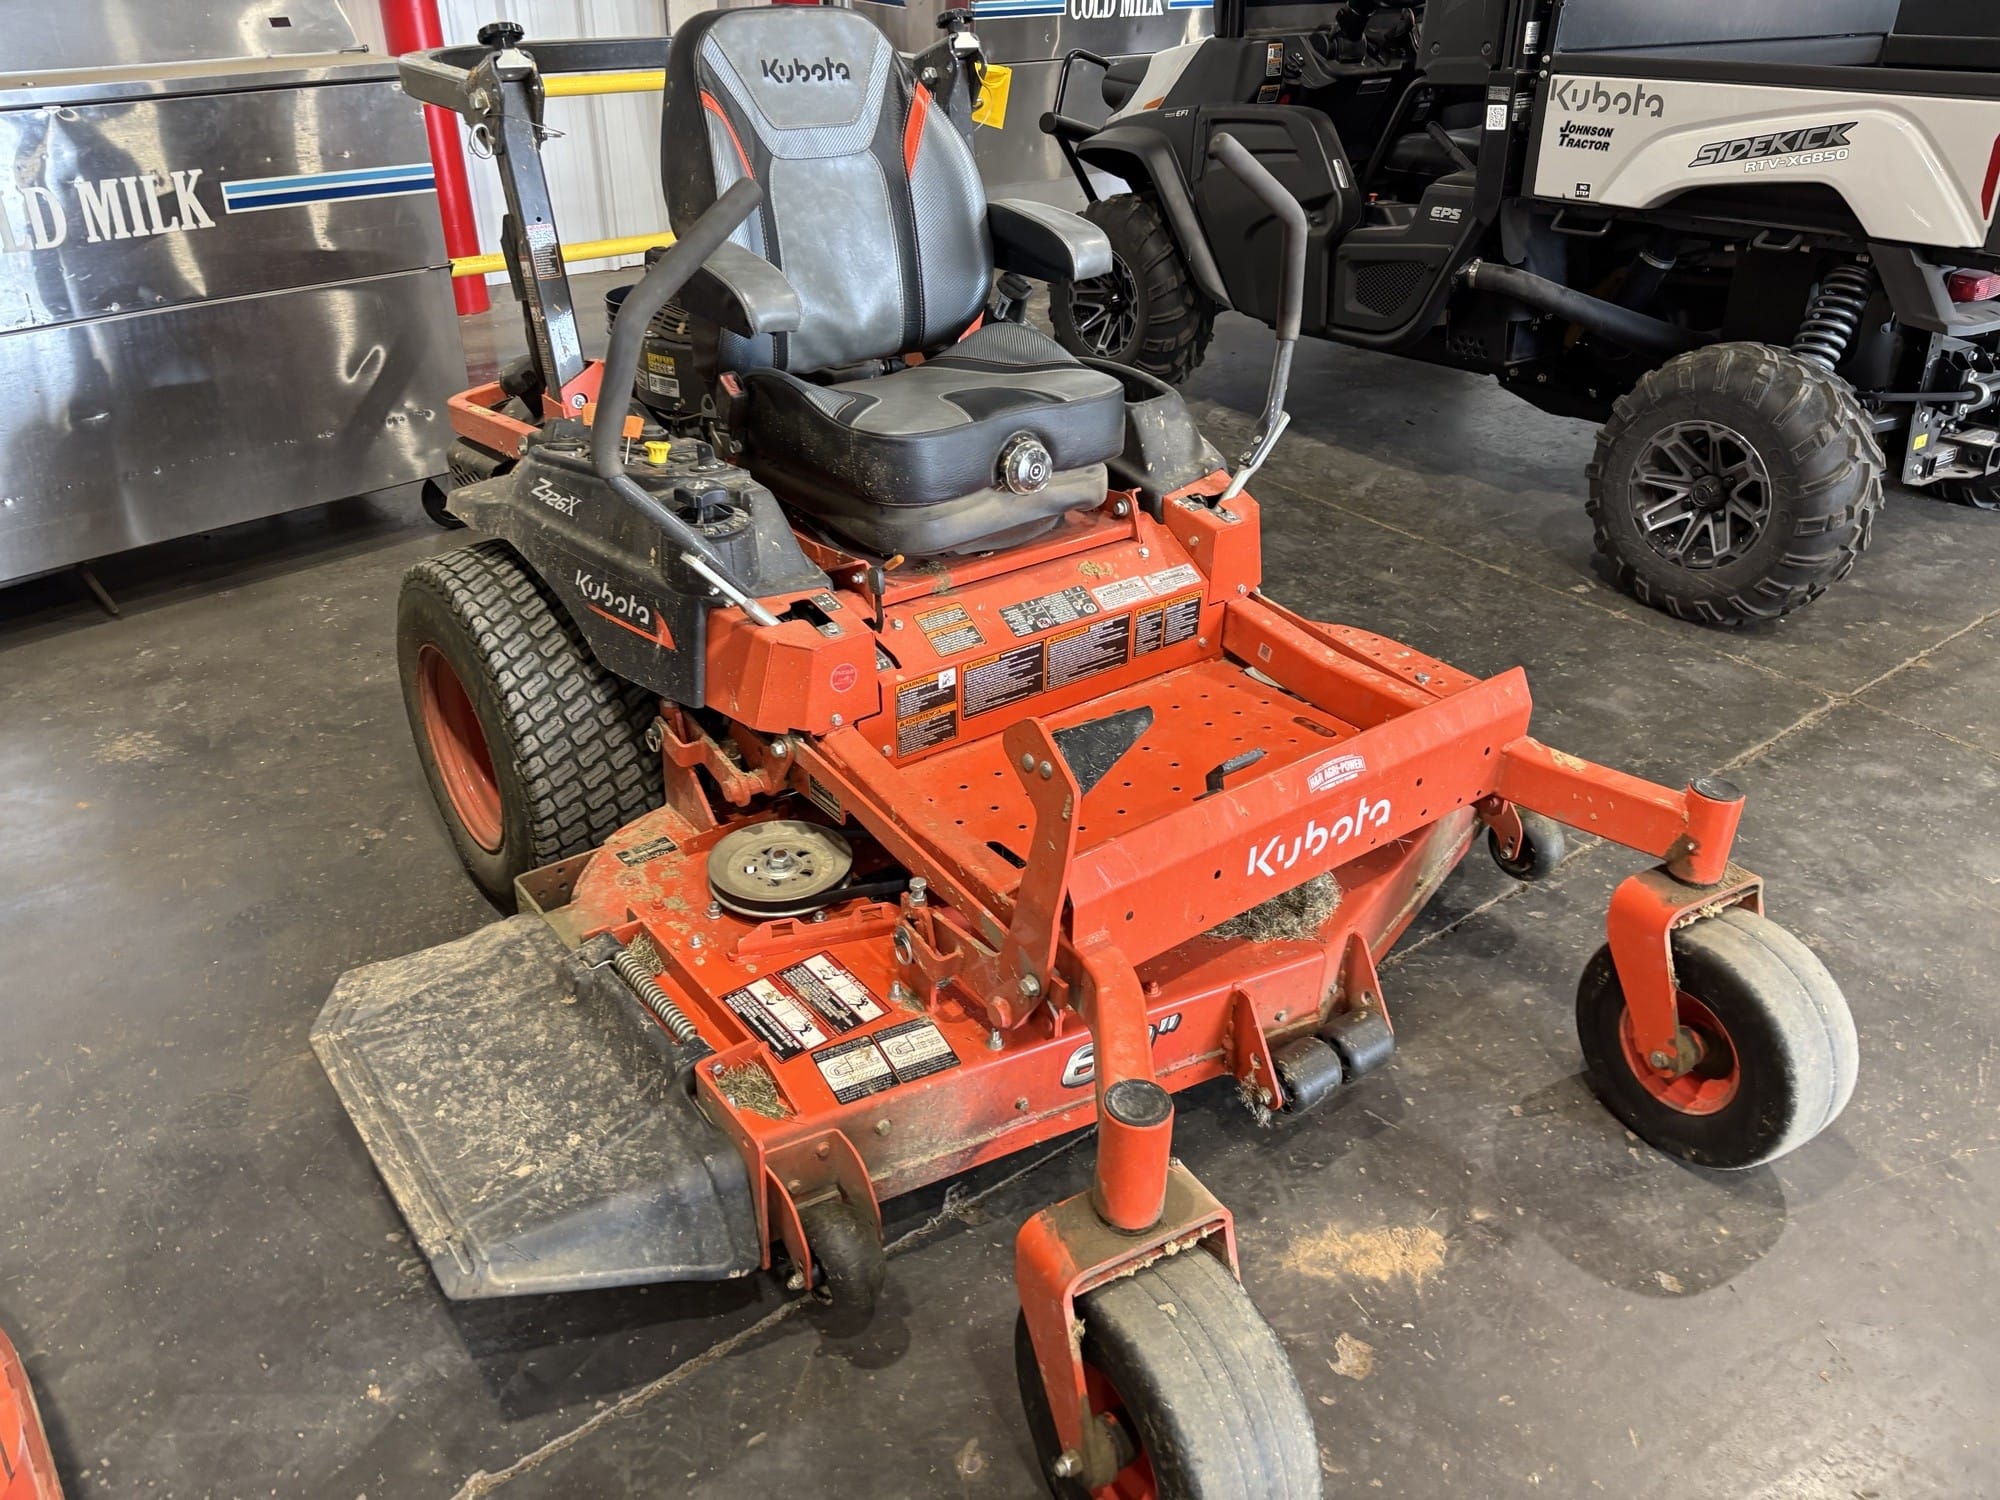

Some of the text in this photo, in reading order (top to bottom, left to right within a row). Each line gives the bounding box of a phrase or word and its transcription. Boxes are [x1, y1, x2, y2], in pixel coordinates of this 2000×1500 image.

[1070, 0, 1164, 20] COLD MILK
[761, 57, 850, 83] Kubota
[1550, 79, 1664, 117] Kubota
[1558, 134, 1610, 151] TRACTOR
[1560, 121, 1614, 138] JOHNSON
[1689, 122, 1858, 167] SIDEKICK
[1744, 149, 1849, 173] RTV-XG850
[74, 169, 216, 243] MILK
[1430, 206, 1463, 220] EPS
[575, 569, 650, 625] Kubota
[1247, 797, 1391, 877] Kubota
